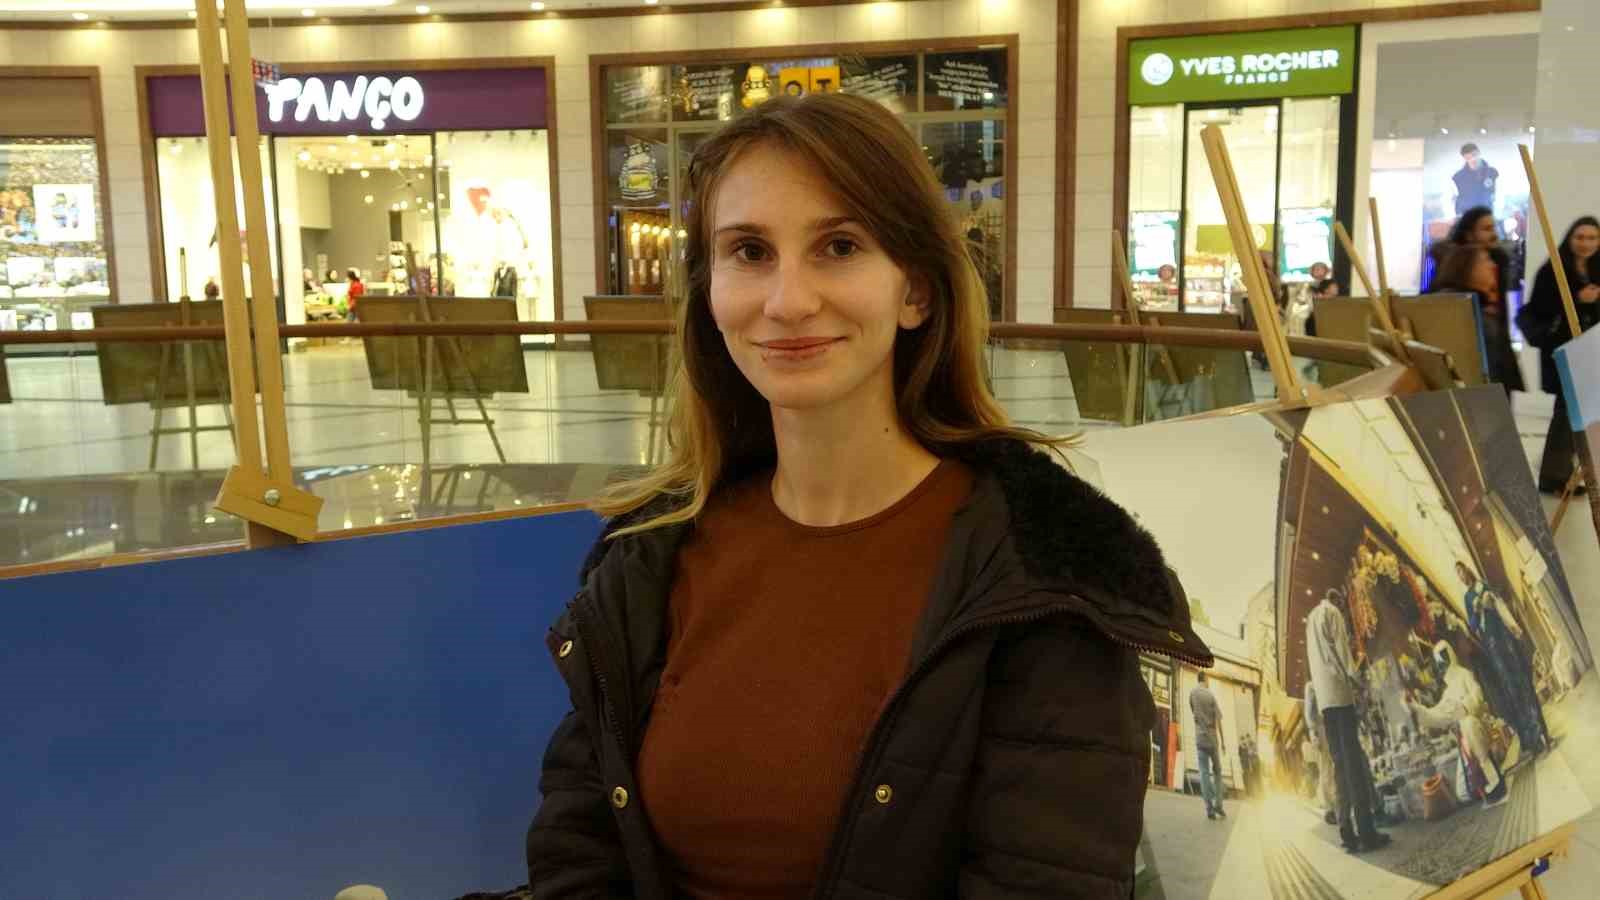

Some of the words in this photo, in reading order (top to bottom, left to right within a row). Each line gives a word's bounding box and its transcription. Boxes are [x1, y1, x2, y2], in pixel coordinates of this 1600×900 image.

[1180, 56, 1236, 76] YVES
[1241, 49, 1339, 72] ROCHER
[1224, 71, 1289, 85] FRANCE
